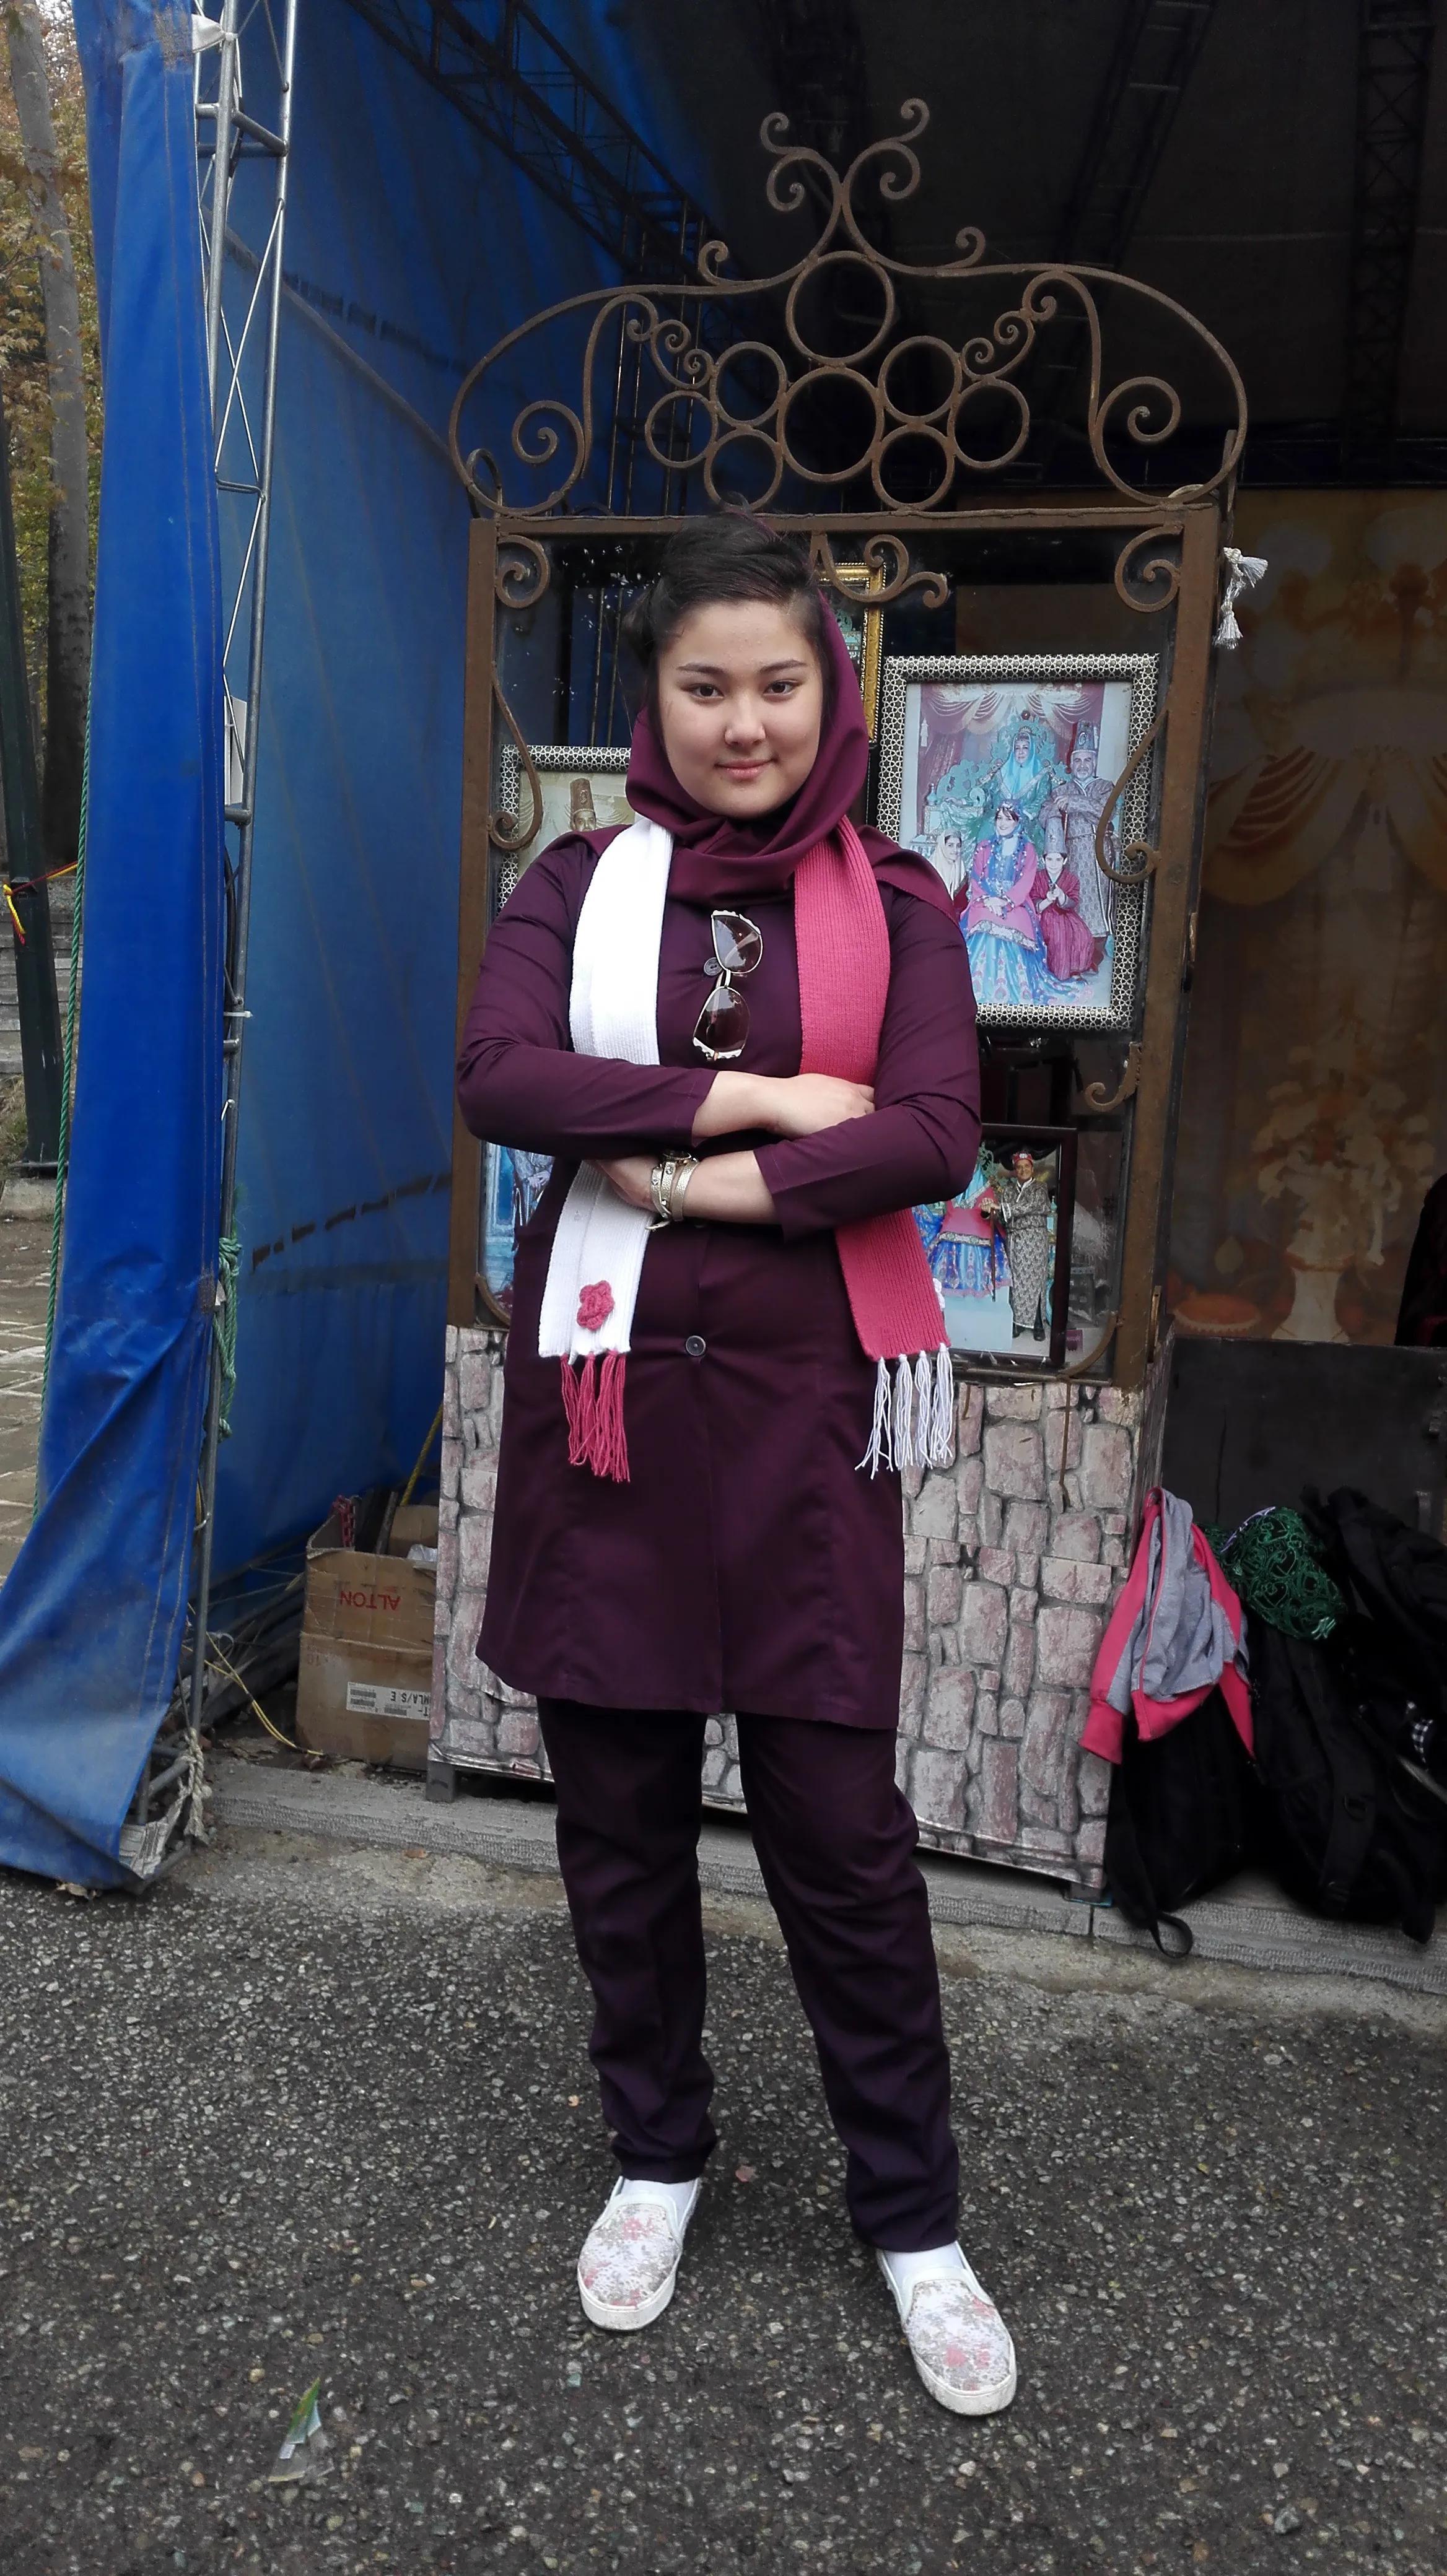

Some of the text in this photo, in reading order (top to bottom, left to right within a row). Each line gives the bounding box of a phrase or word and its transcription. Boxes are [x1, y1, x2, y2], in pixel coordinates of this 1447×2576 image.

[340, 1590, 401, 1610] ALTON
[401, 1692, 430, 1705] MLA/S
[417, 1707, 430, 1717] T-
